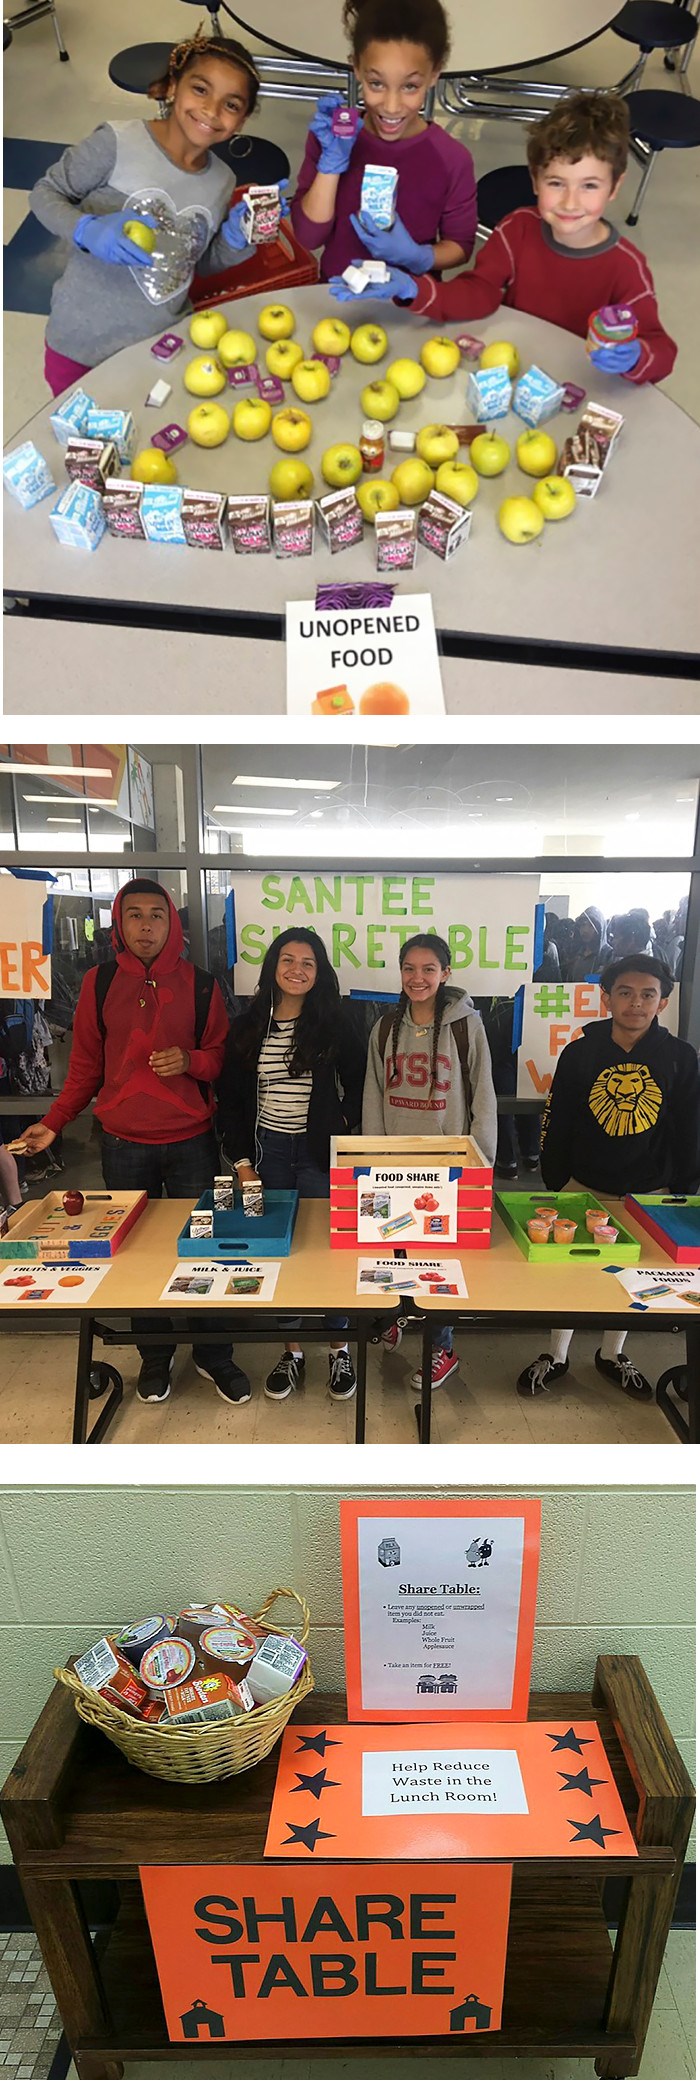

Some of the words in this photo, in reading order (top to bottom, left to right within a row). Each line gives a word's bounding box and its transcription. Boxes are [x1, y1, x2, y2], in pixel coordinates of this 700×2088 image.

[299, 615, 420, 638] UNOPENED
[331, 647, 393, 668] FOOD
[261, 874, 435, 916] SANTEE
[240, 923, 530, 970] SRETBLE
[386, 1052, 452, 1093] USC
[375, 1173, 404, 1182] FOOD
[406, 1172, 440, 1182] SHARE
[398, 1584, 437, 1595] Share
[440, 1584, 481, 1595] Table:
[392, 1763, 428, 1773] Help
[433, 1761, 490, 1771] Reduce
[392, 1777, 442, 1786] Waste
[447, 1776, 462, 1786] in
[466, 1776, 492, 1786] the
[390, 1792, 440, 1803] Lunch
[445, 1791, 497, 1802] Room!
[194, 1893, 456, 1945] SHARE
[211, 1952, 456, 1998] TABLE
